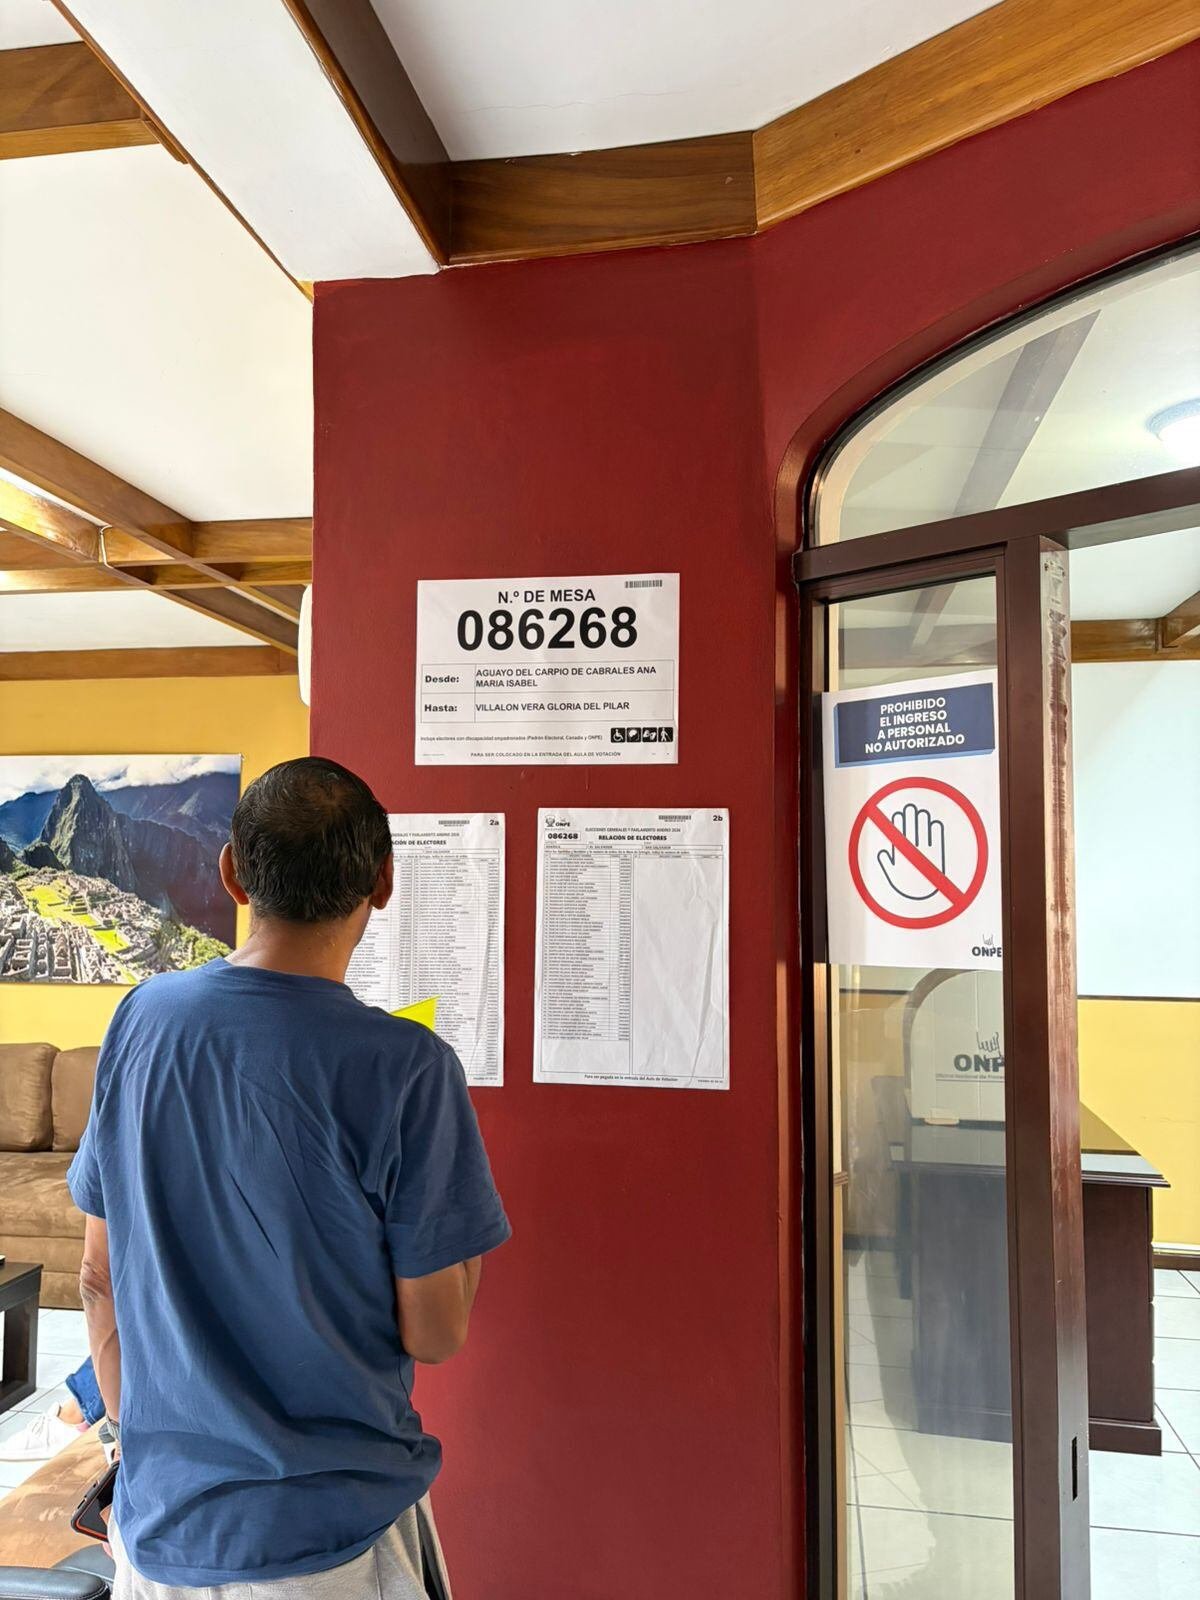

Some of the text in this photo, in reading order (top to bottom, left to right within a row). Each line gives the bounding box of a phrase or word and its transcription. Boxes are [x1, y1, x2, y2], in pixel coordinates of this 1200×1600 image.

[524, 590, 545, 603] DE
[550, 589, 595, 602] MESA
[457, 606, 638, 651] 086268
[425, 675, 459, 683] Desde:
[476, 668, 513, 677] AGUAYO
[516, 668, 533, 676] DEL
[535, 668, 569, 676] CARPIO
[572, 667, 584, 675] DE
[586, 667, 635, 675] CABRALES
[476, 679, 537, 687] MARIA ISABEL
[425, 704, 457, 712] Hasta:
[476, 704, 519, 712] VILLALON
[521, 703, 545, 711] VERA
[548, 703, 581, 711] GLORIA
[603, 702, 629, 710] PILAR
[880, 697, 946, 715] PROHIBIDO
[880, 710, 947, 726] EL INGRESO
[878, 723, 951, 739] A PERSONAL
[866, 734, 964, 754] NO AUTORIZADO
[972, 946, 1002, 958] ONPE
[954, 1054, 1005, 1072] ONP
